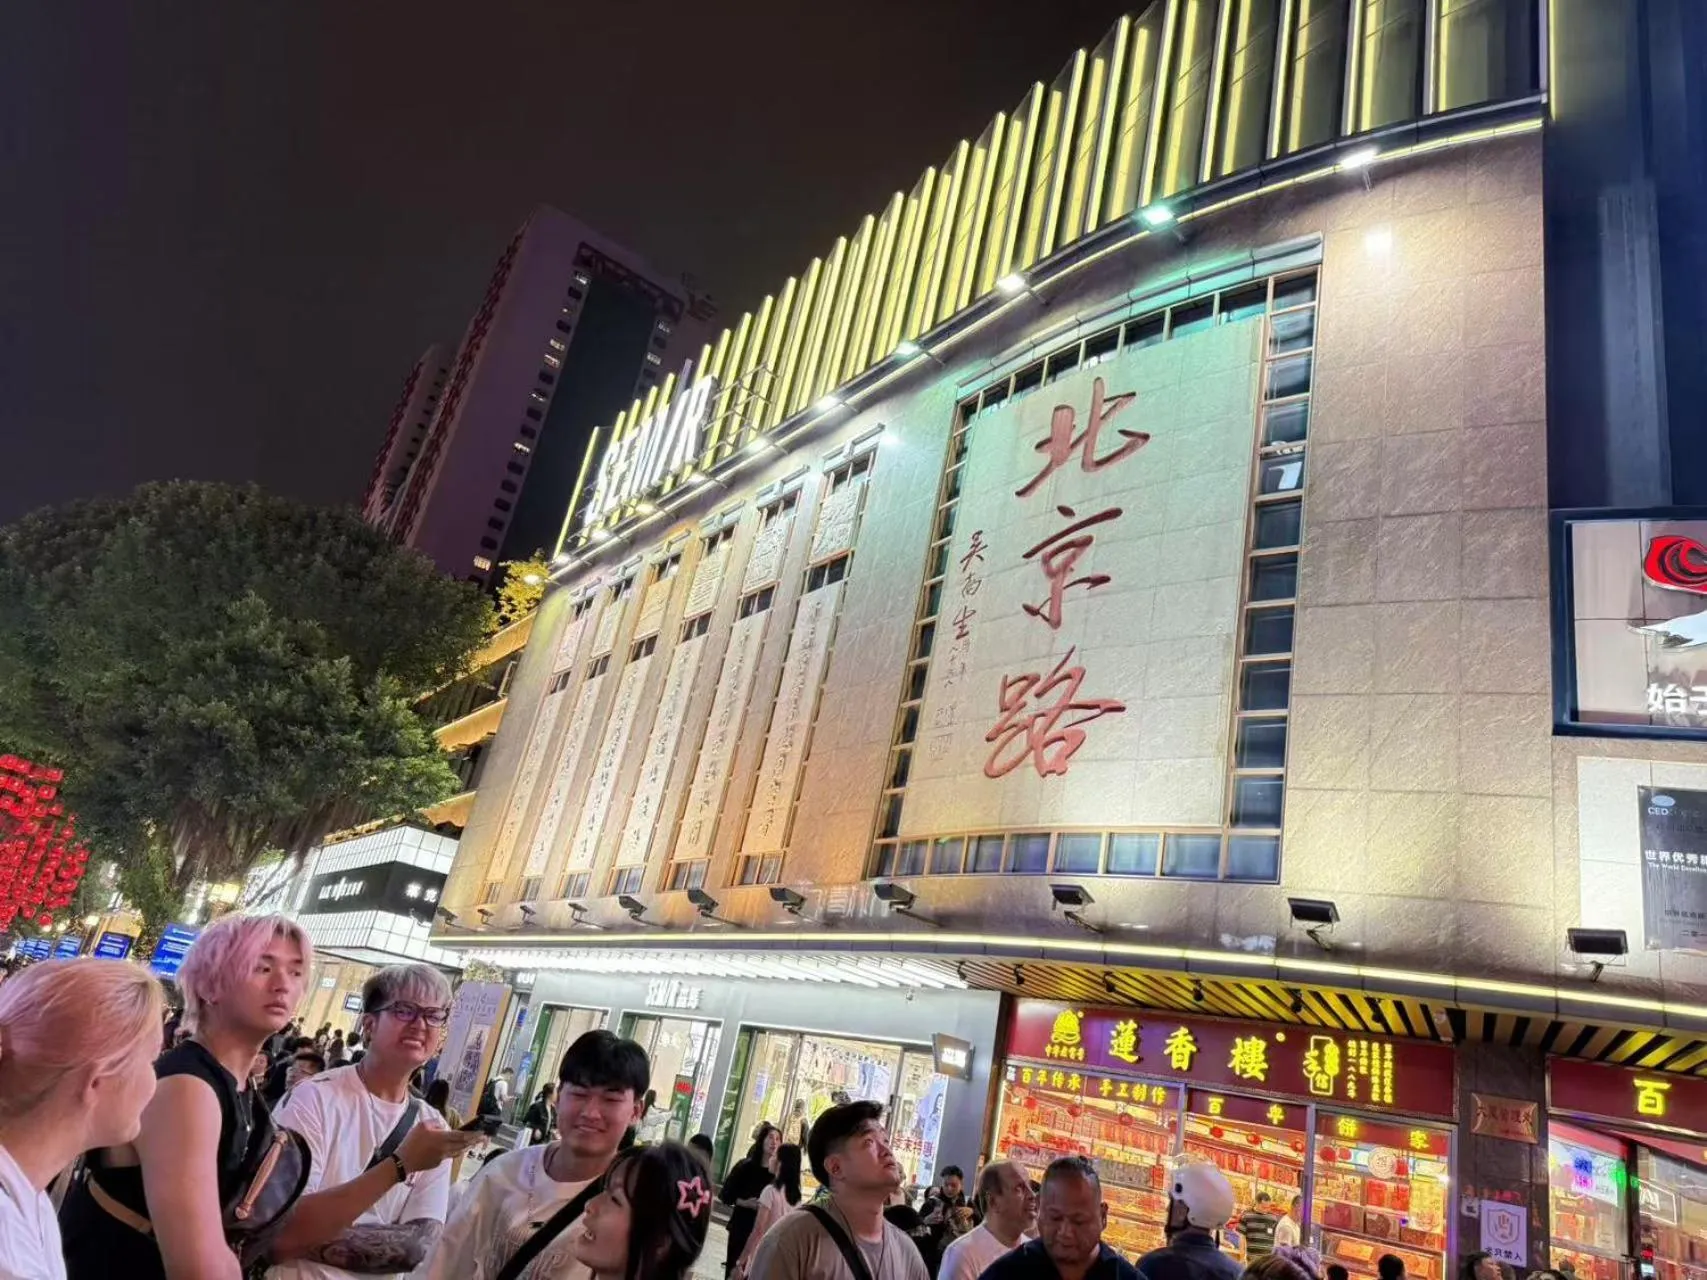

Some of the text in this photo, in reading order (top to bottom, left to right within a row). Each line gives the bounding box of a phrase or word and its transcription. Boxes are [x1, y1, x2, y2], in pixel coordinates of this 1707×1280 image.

[584, 374, 719, 531] SEMIR
[984, 376, 1150, 778] 北京路
[1108, 1019, 1269, 1082] 蓮香樓
[1633, 1078, 1672, 1116] 百
